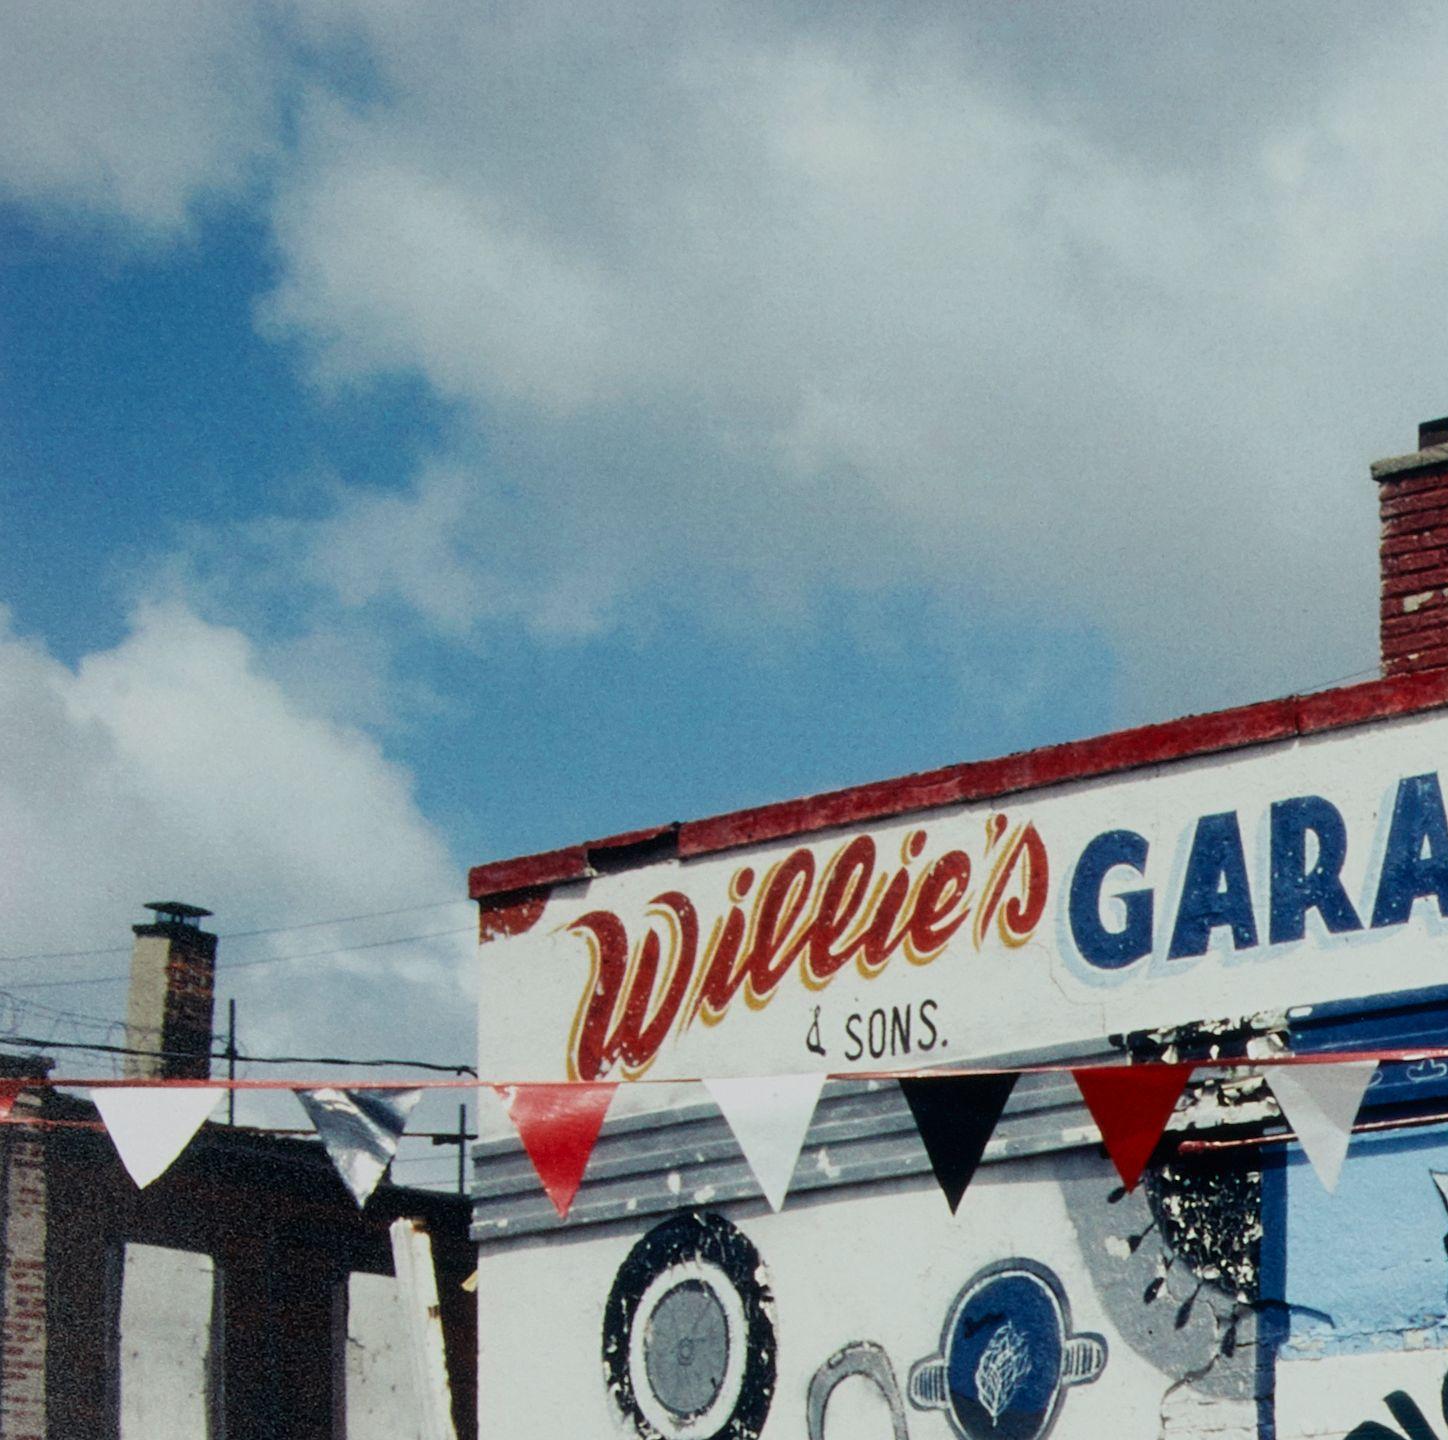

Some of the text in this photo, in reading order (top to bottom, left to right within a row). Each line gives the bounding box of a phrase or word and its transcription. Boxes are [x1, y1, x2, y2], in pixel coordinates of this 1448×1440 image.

[552, 812, 1050, 1082] Willie's
[805, 998, 949, 1061] & SONS.
